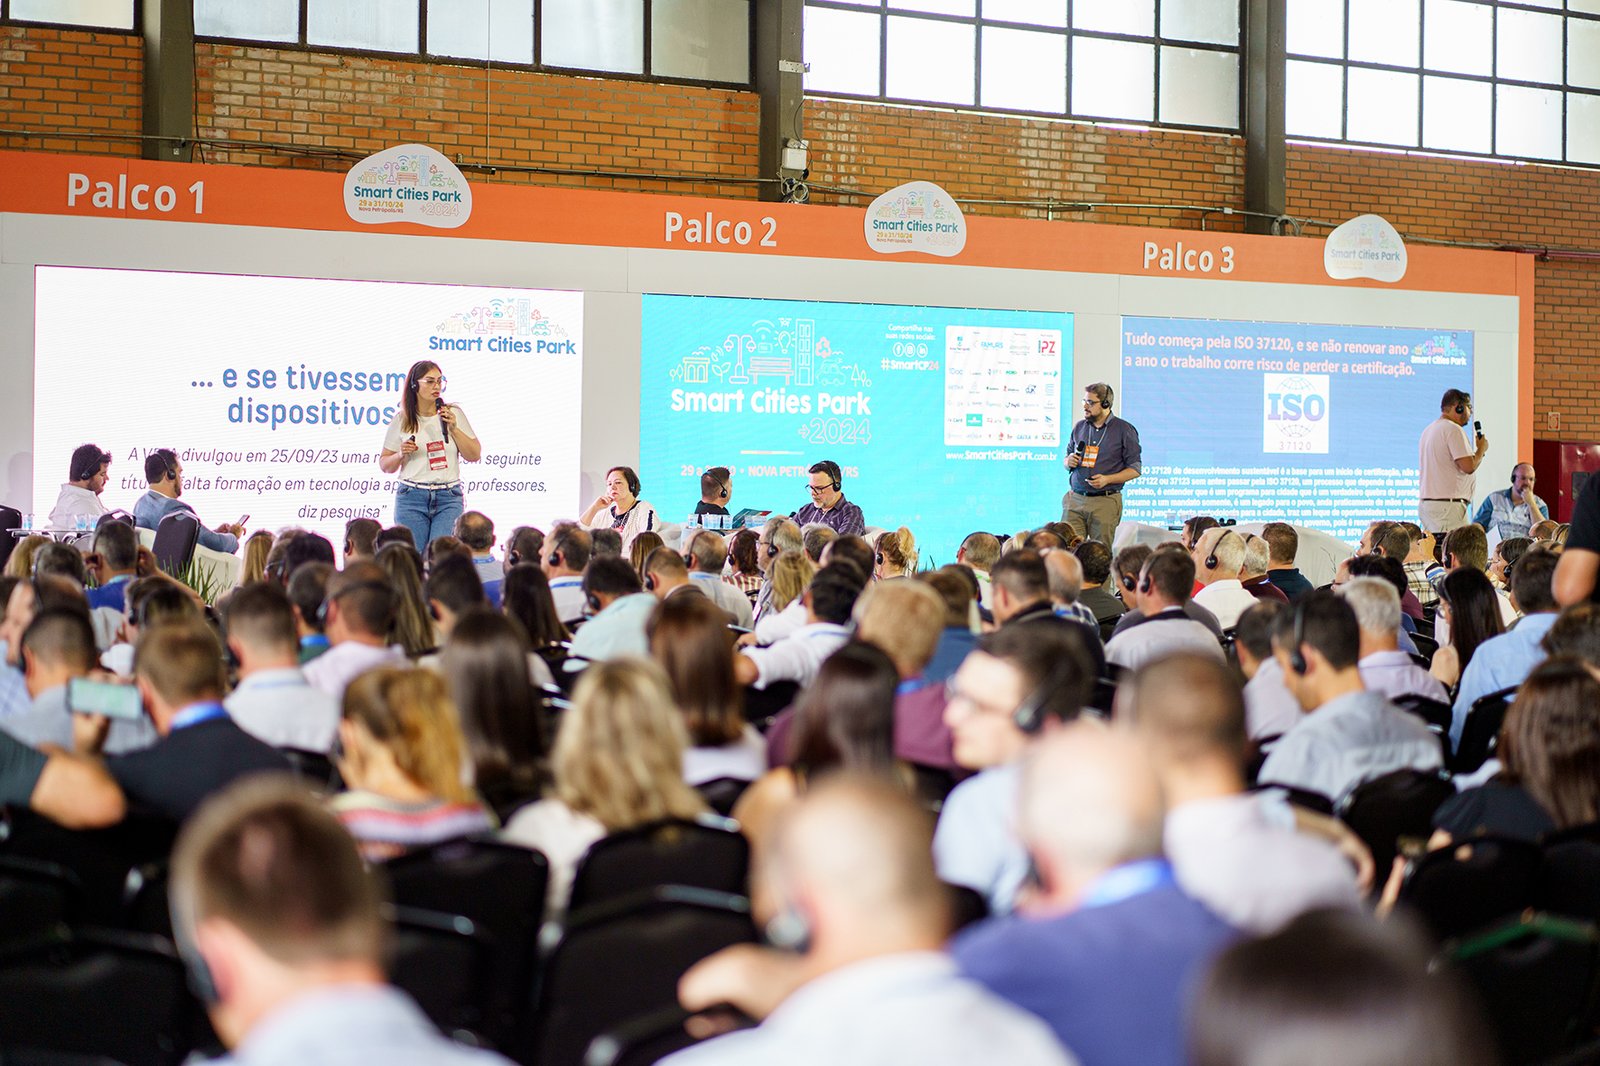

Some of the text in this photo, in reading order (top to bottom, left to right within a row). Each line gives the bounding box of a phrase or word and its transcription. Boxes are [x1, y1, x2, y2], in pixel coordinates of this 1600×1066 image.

[67, 173, 205, 214] Palco 1
[354, 186, 463, 203] Smart Cities Park
[425, 203, 460, 217] 2024
[665, 212, 777, 247] Palco 2
[873, 219, 959, 233] Smart Cities Park
[1143, 242, 1235, 273] Palco 3
[1331, 249, 1400, 262] Smart Cities Park
[429, 336, 577, 355] Smart Cities Park
[1125, 331, 1409, 355] Tudo começa pela ISO 37120, e se não renovar ano
[1125, 355, 1415, 378] a ano o trabalho corre risco de perder a certificação.
[1450, 357, 1467, 366] Park
[223, 368, 238, 388] e
[247, 369, 277, 389] se
[286, 364, 407, 391] tivessem
[671, 387, 872, 416] Smart Cities Park
[1267, 393, 1325, 421] ISO
[228, 397, 402, 431] dispositivos
[810, 418, 872, 444] 2024
[946, 450, 1058, 461] www.SmartCitiesPark.com.br
[1280, 441, 1312, 451] 37120
[128, 447, 139, 461] A
[182, 447, 242, 466] divulgou
[246, 451, 267, 462] em
[270, 449, 338, 466] 25/09/23
[341, 452, 370, 464] uma
[485, 452, 541, 469] seguinte
[681, 464, 695, 477] 29
[748, 465, 779, 478] NOVA
[215, 476, 283, 495] formação
[285, 480, 305, 491] em
[309, 477, 382, 495] tecnologia
[467, 479, 547, 496] professores,
[298, 505, 318, 519] diz
